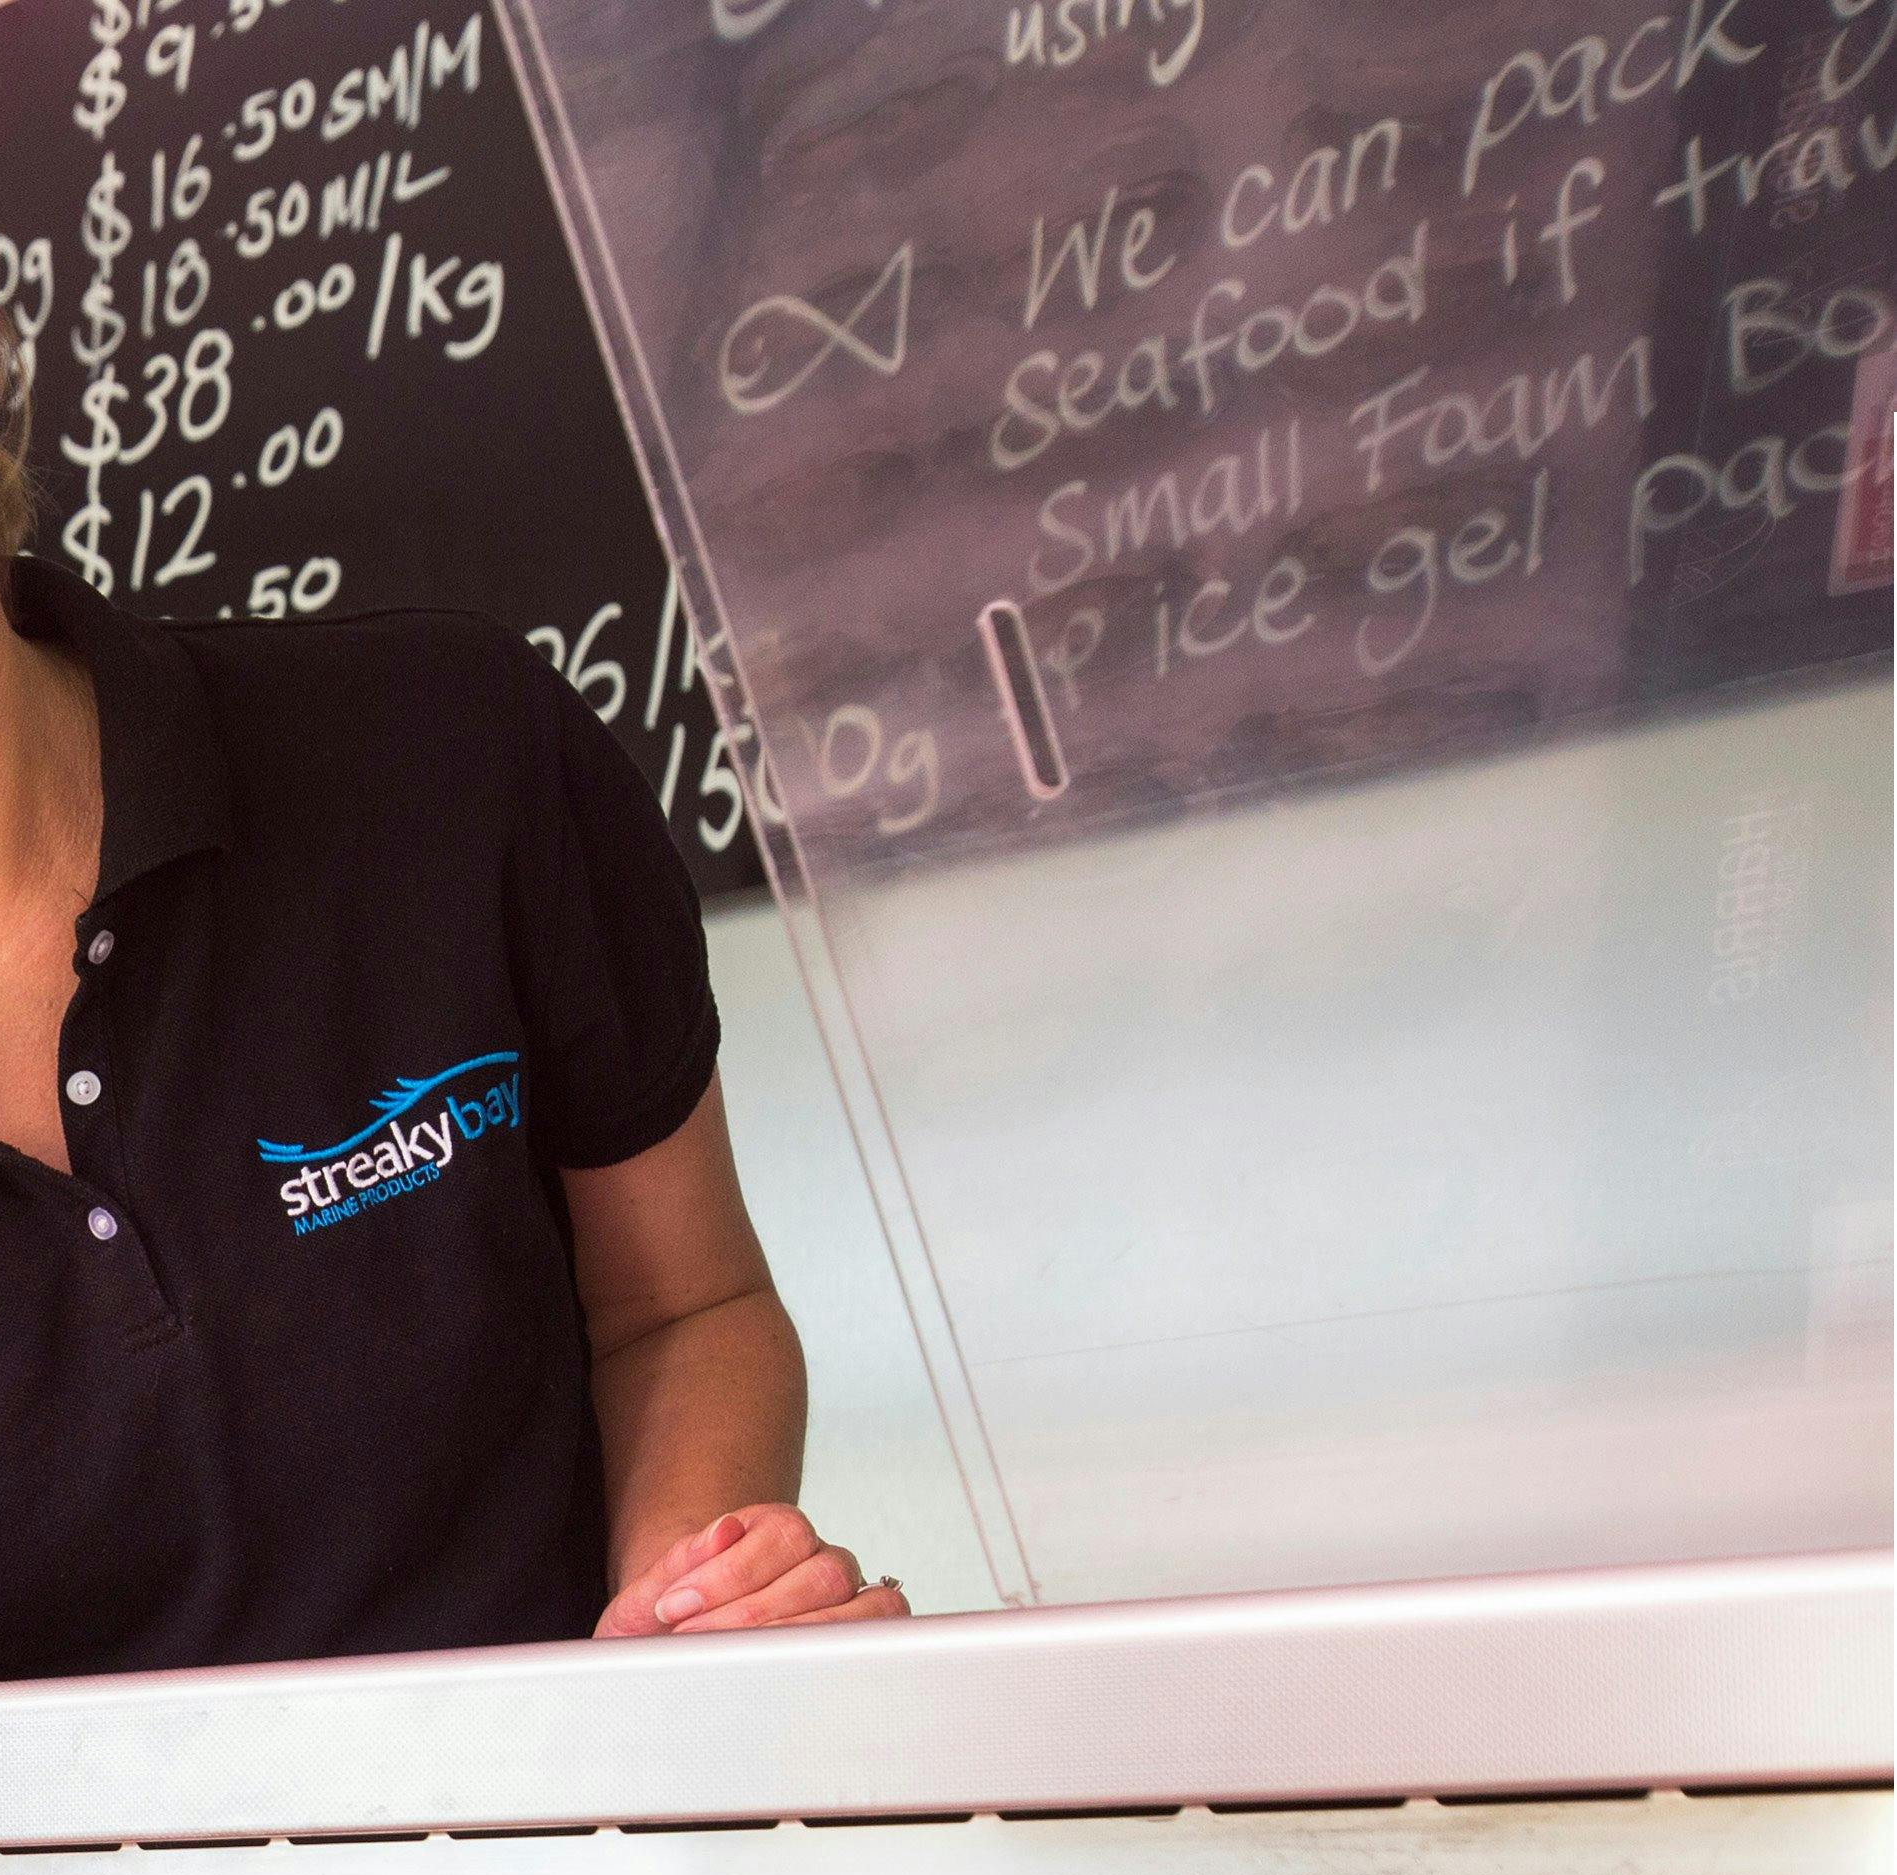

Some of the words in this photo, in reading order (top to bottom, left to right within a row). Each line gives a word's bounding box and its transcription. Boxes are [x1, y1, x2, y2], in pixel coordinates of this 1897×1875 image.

[1023, 186, 1177, 331] We
[1220, 117, 1402, 250] can
[1460, 0, 1767, 197] pack
[1504, 156, 1607, 305] if
[1027, 413, 1301, 596] Small
[1348, 331, 1656, 494] Foam
[1155, 558, 1318, 678] ice
[1355, 468, 1550, 676] gel
[293, 1194, 360, 1237] MARINE
[359, 1160, 442, 1211] PRODUCTS
